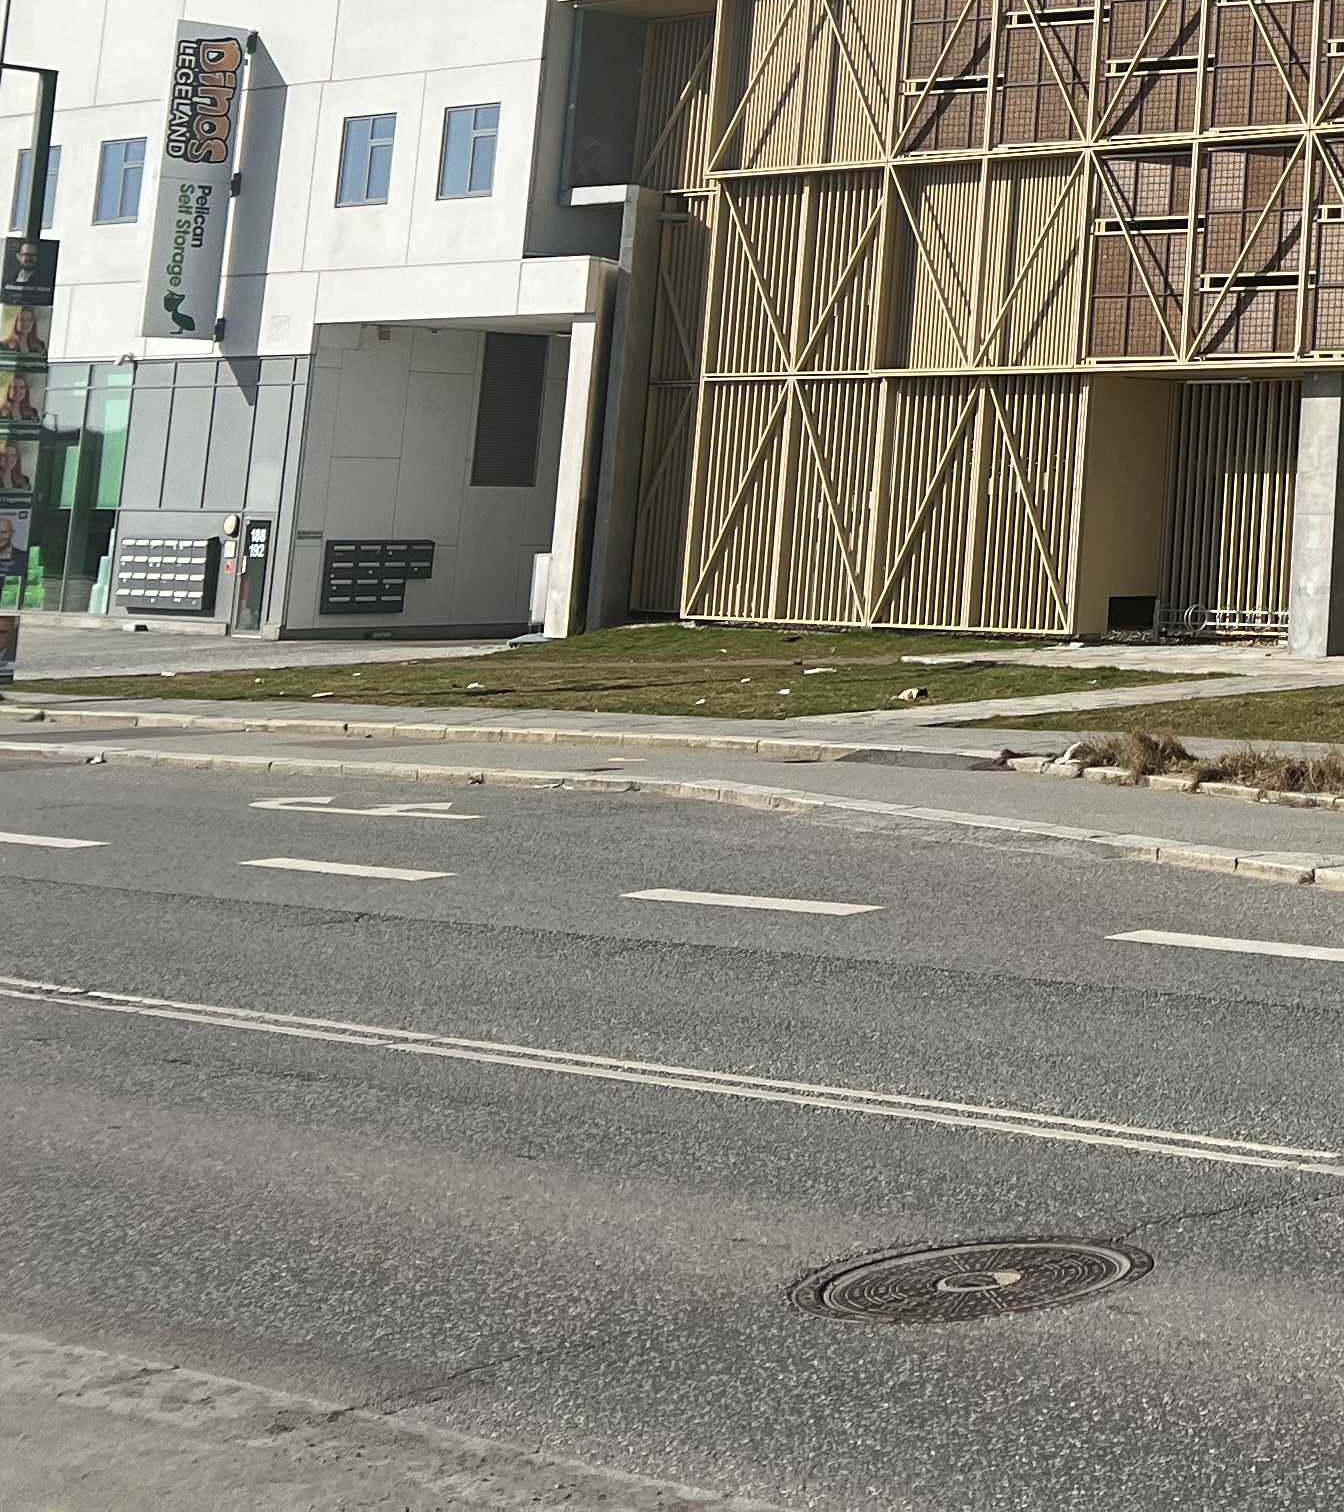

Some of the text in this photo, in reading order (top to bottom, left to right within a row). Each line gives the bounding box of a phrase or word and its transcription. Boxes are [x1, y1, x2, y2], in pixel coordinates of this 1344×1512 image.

[166, 40, 198, 159] LEGELAND
[187, 38, 242, 164] Dinos
[167, 184, 194, 287] Self Storage
[191, 185, 212, 248] Pelican
